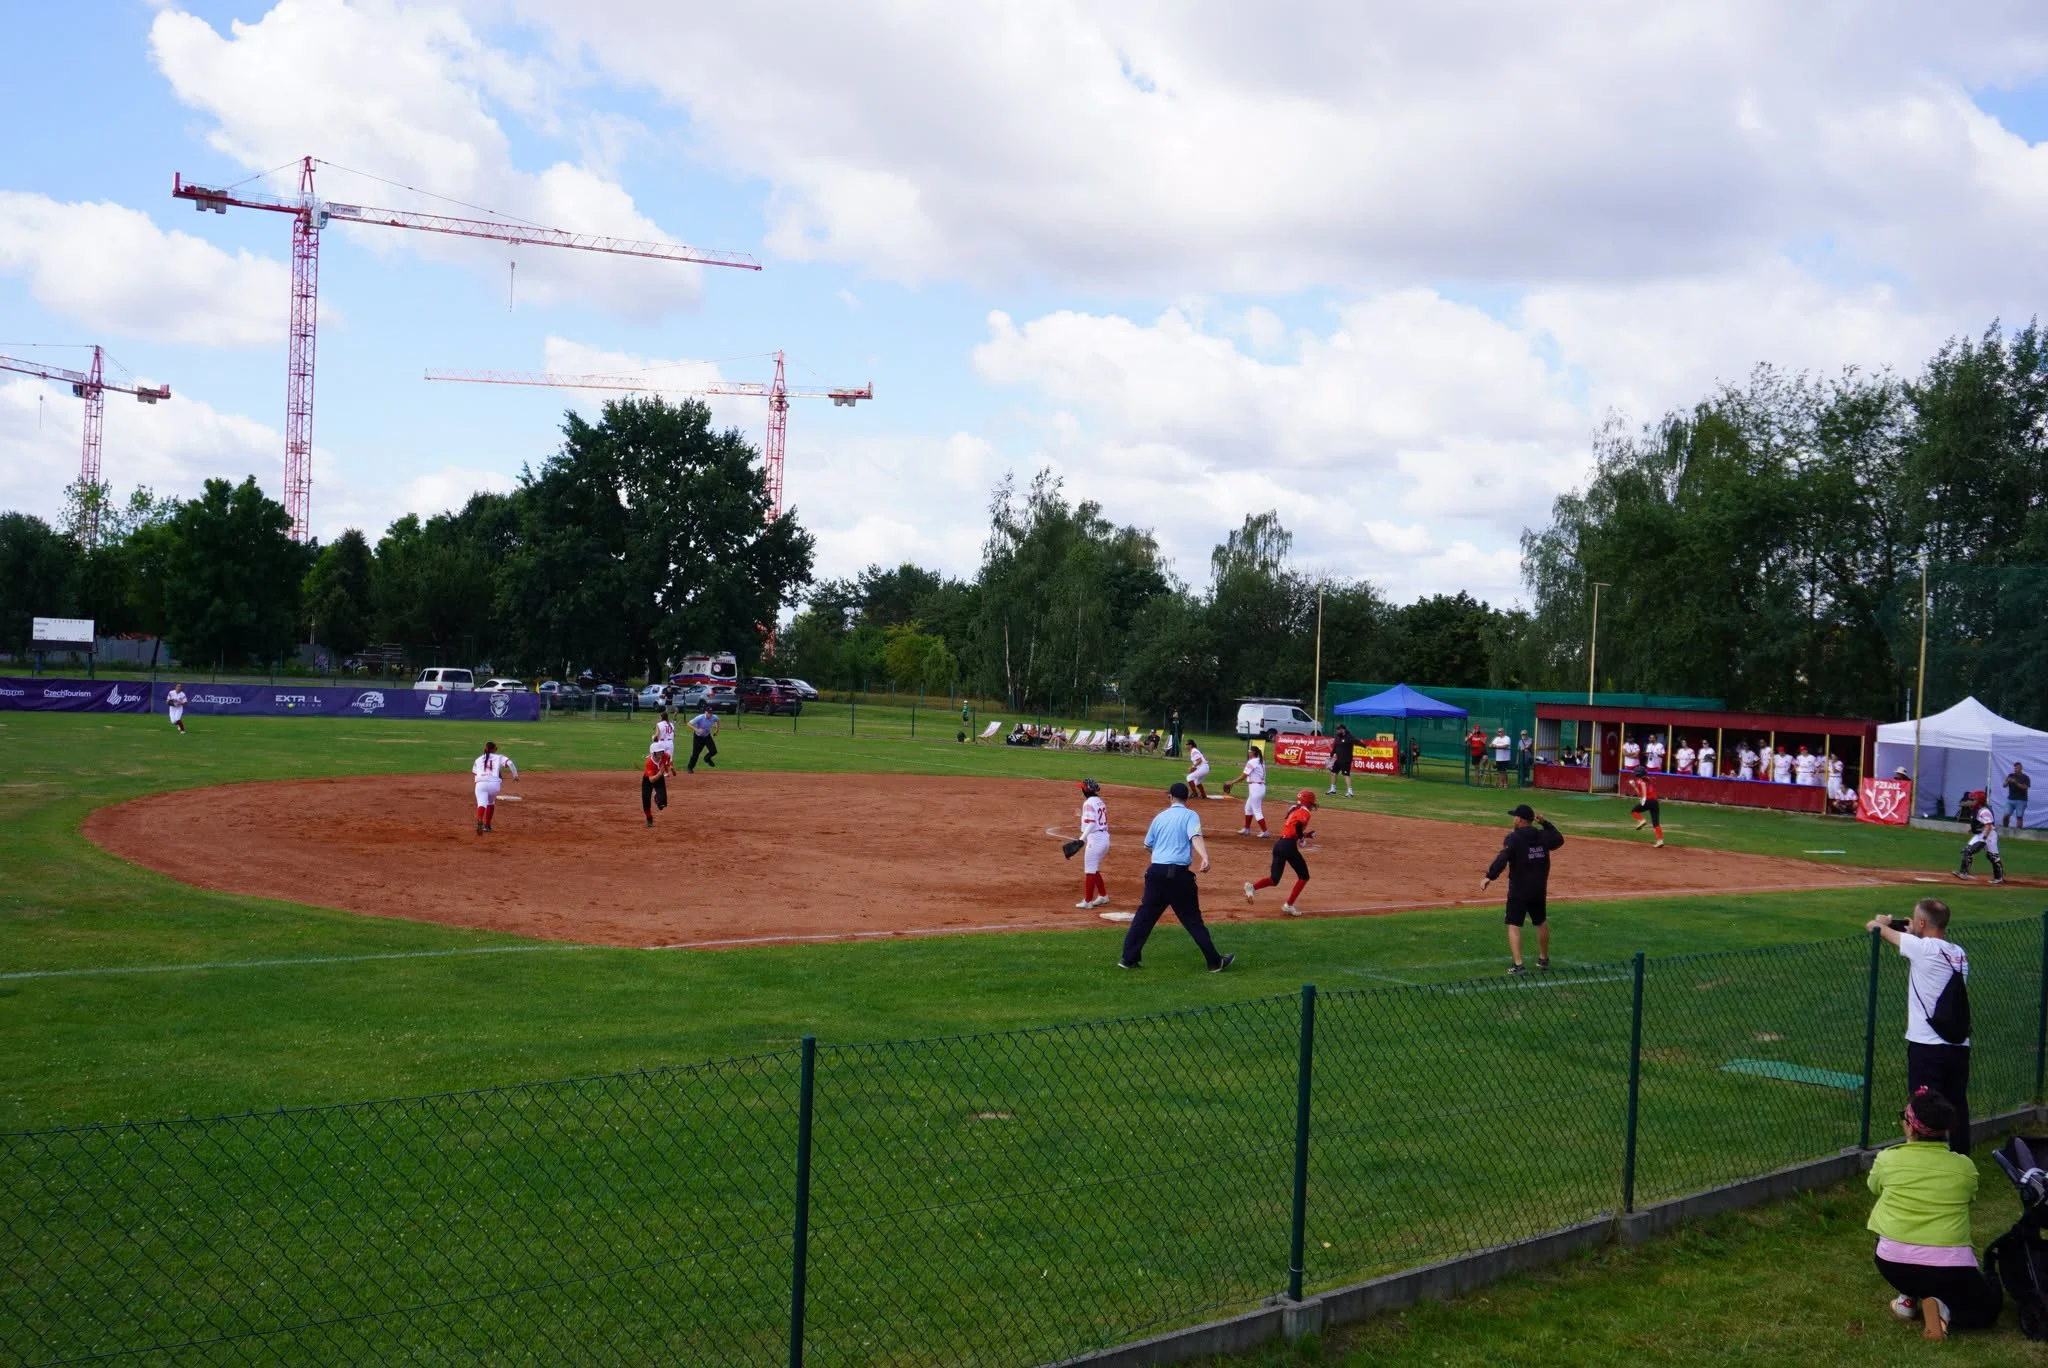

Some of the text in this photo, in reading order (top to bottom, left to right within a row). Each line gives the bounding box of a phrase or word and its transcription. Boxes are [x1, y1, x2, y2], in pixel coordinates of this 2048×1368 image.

[43, 689, 91, 697] CzechTourism
[205, 695, 241, 704] Kappa
[1284, 748, 1299, 756] KFC
